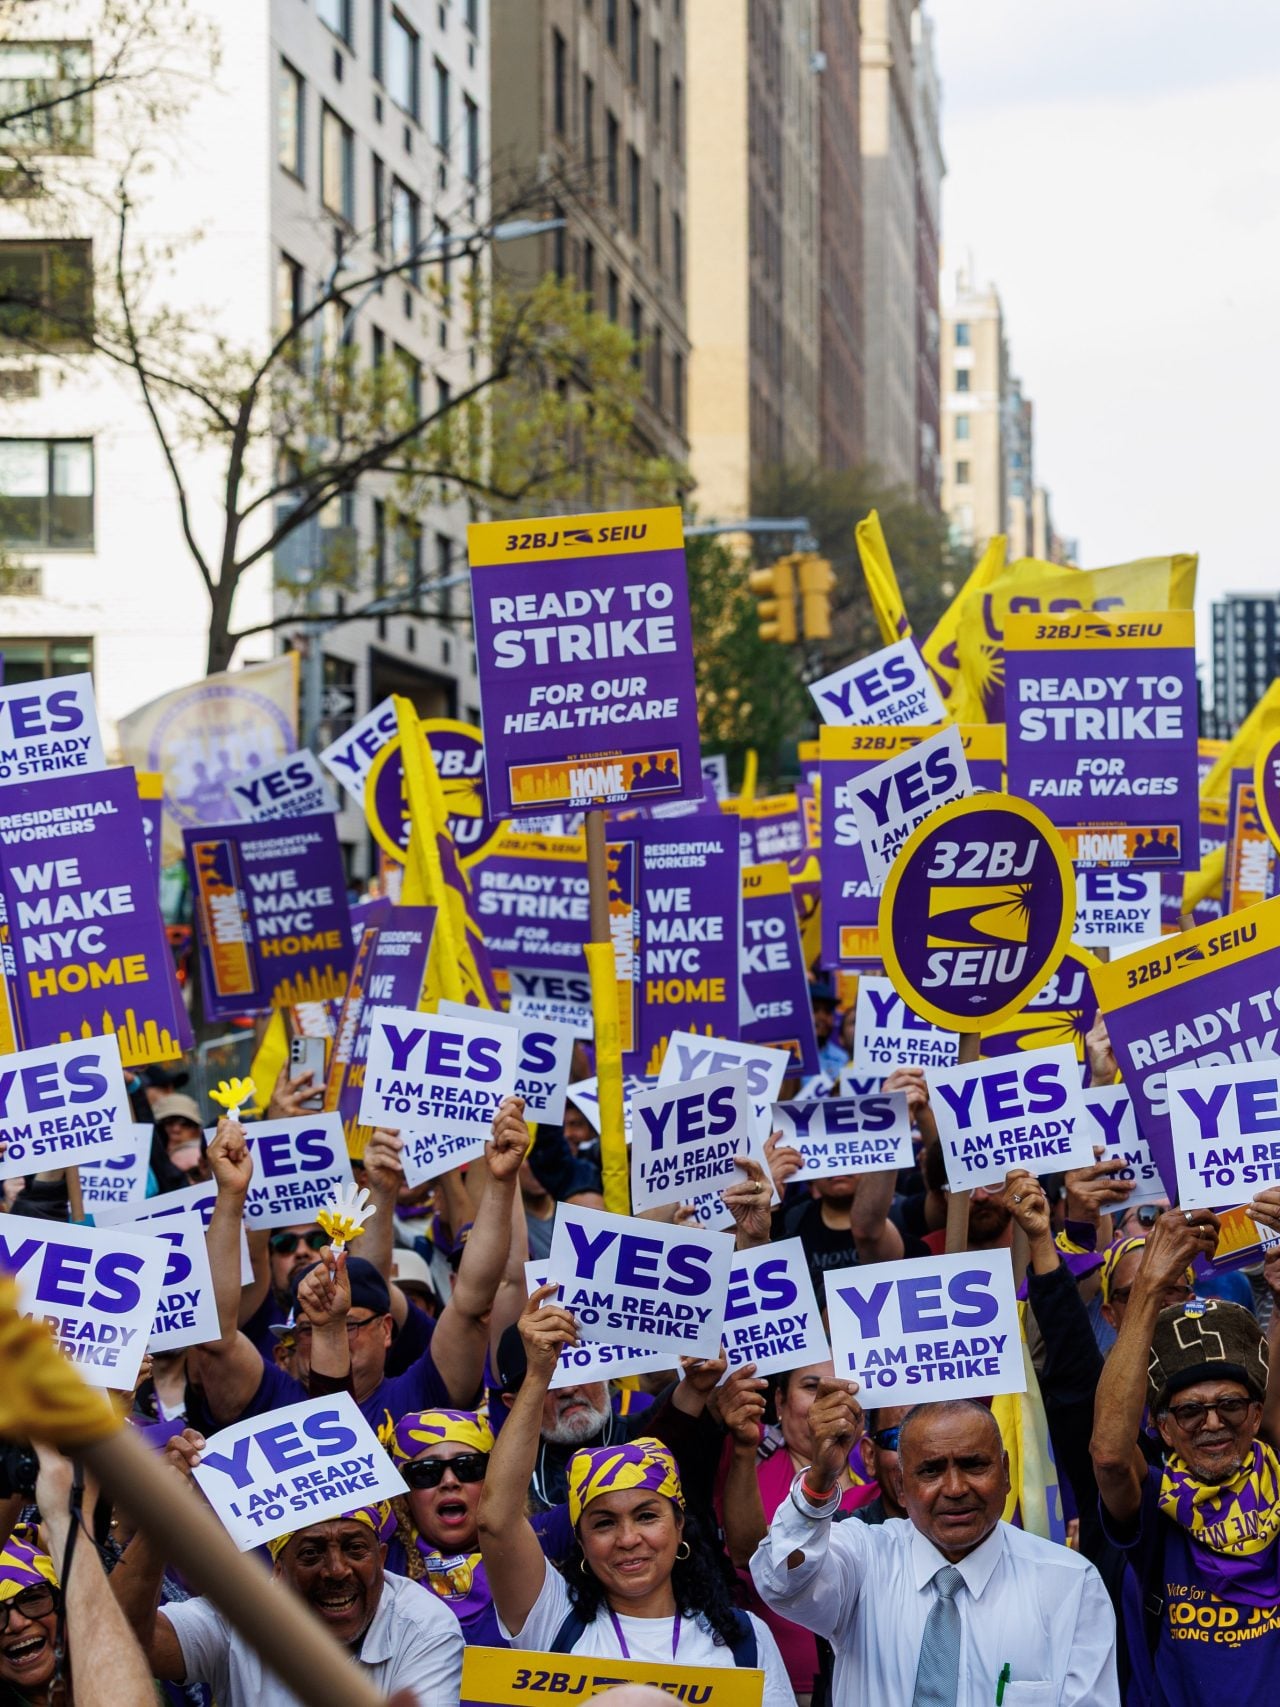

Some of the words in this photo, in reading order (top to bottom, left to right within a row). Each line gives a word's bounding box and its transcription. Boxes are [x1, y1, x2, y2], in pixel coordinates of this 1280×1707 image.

[505, 532, 559, 551] 32BJ
[598, 524, 647, 542] SEIU
[490, 587, 615, 624] READY
[624, 582, 673, 612] TO
[493, 616, 677, 668] STRIKE
[1035, 624, 1082, 639] 32BJ
[1116, 624, 1162, 637] SEIU
[529, 682, 583, 707] FOR
[591, 676, 647, 700] OUR
[821, 656, 916, 718] YES
[1020, 678, 1129, 701] READY
[1137, 676, 1183, 701] TO
[504, 698, 679, 735] HEALTHCARE
[1020, 706, 1184, 741] STRIKE
[579, 750, 622, 759] RESIDENTIAL
[1076, 758, 1125, 776] FOR
[234, 762, 314, 807] YES
[570, 764, 624, 797] HOME
[857, 746, 957, 828] YES
[1029, 778, 1083, 797] FAIR
[1089, 778, 1179, 796] WAGES
[0, 801, 117, 829] RESIDENTIAL
[568, 796, 592, 807] 32BJ
[606, 792, 628, 803] SEIU
[1, 818, 95, 844] WORKERS
[241, 834, 322, 851] RESIDENTIAL
[1077, 833, 1127, 860] HOME
[242, 844, 308, 862] WORKERS
[644, 841, 724, 857] RESIDENTIAL
[644, 854, 706, 869] WORKERS
[928, 839, 1038, 878] 32BJ
[1076, 860, 1098, 869] 32BJ
[10, 858, 81, 893] WE
[249, 870, 298, 892] WE
[480, 871, 556, 893] READY
[560, 878, 590, 895] TO
[16, 885, 135, 929] MAKE
[254, 887, 333, 914] MAKE
[478, 890, 589, 921] STRIKE
[646, 887, 692, 913] WE
[258, 912, 314, 935] NYC
[646, 917, 723, 943] MAKE
[22, 926, 106, 963] NYC
[261, 932, 342, 958] HOME
[1127, 955, 1173, 988] 32BJ
[1208, 923, 1257, 956] SEIU
[28, 955, 148, 998] HOME
[646, 949, 700, 974] NYC
[922, 947, 1028, 987] SEIU
[646, 978, 726, 1005] HOME
[381, 1024, 502, 1082] YES
[1128, 1007, 1242, 1070] READY
[382, 1096, 411, 1114] TO
[417, 1100, 493, 1124] STRIKE
[389, 1080, 424, 1098] AM
[431, 1084, 504, 1109] READY
[935, 1063, 1068, 1129] YES
[639, 1085, 737, 1151] YES
[778, 1097, 897, 1137] YES
[836, 1137, 901, 1155] READY
[963, 1136, 994, 1154] AM
[999, 1118, 1076, 1145] READY
[650, 1155, 678, 1176] AM
[683, 1137, 740, 1167] READY
[962, 1153, 987, 1172] TO
[991, 1137, 1072, 1167] STRIKE
[1203, 1146, 1244, 1168] AM
[646, 1176, 669, 1193] TO
[674, 1158, 734, 1187] STRIKE
[1199, 1169, 1235, 1188] TO
[564, 1221, 713, 1296] YES
[569, 1287, 614, 1308] AM
[622, 1292, 713, 1324] READY
[836, 1270, 999, 1339] YES
[568, 1306, 600, 1325] TO
[606, 1311, 699, 1340] STRIKE
[864, 1346, 906, 1368] AM
[916, 1334, 1007, 1362] READY
[860, 1367, 897, 1389] TO
[906, 1356, 1001, 1385] STRIKE
[200, 1410, 357, 1489] YES
[250, 1482, 289, 1509] AM
[293, 1454, 376, 1488] READY
[247, 1506, 285, 1527] TO
[290, 1472, 380, 1511] STRIKE
[1167, 1583, 1188, 1596] Vote
[1188, 1585, 1206, 1600] for
[1169, 1602, 1239, 1627] GOOD
[511, 1669, 588, 1695] 32BJ
